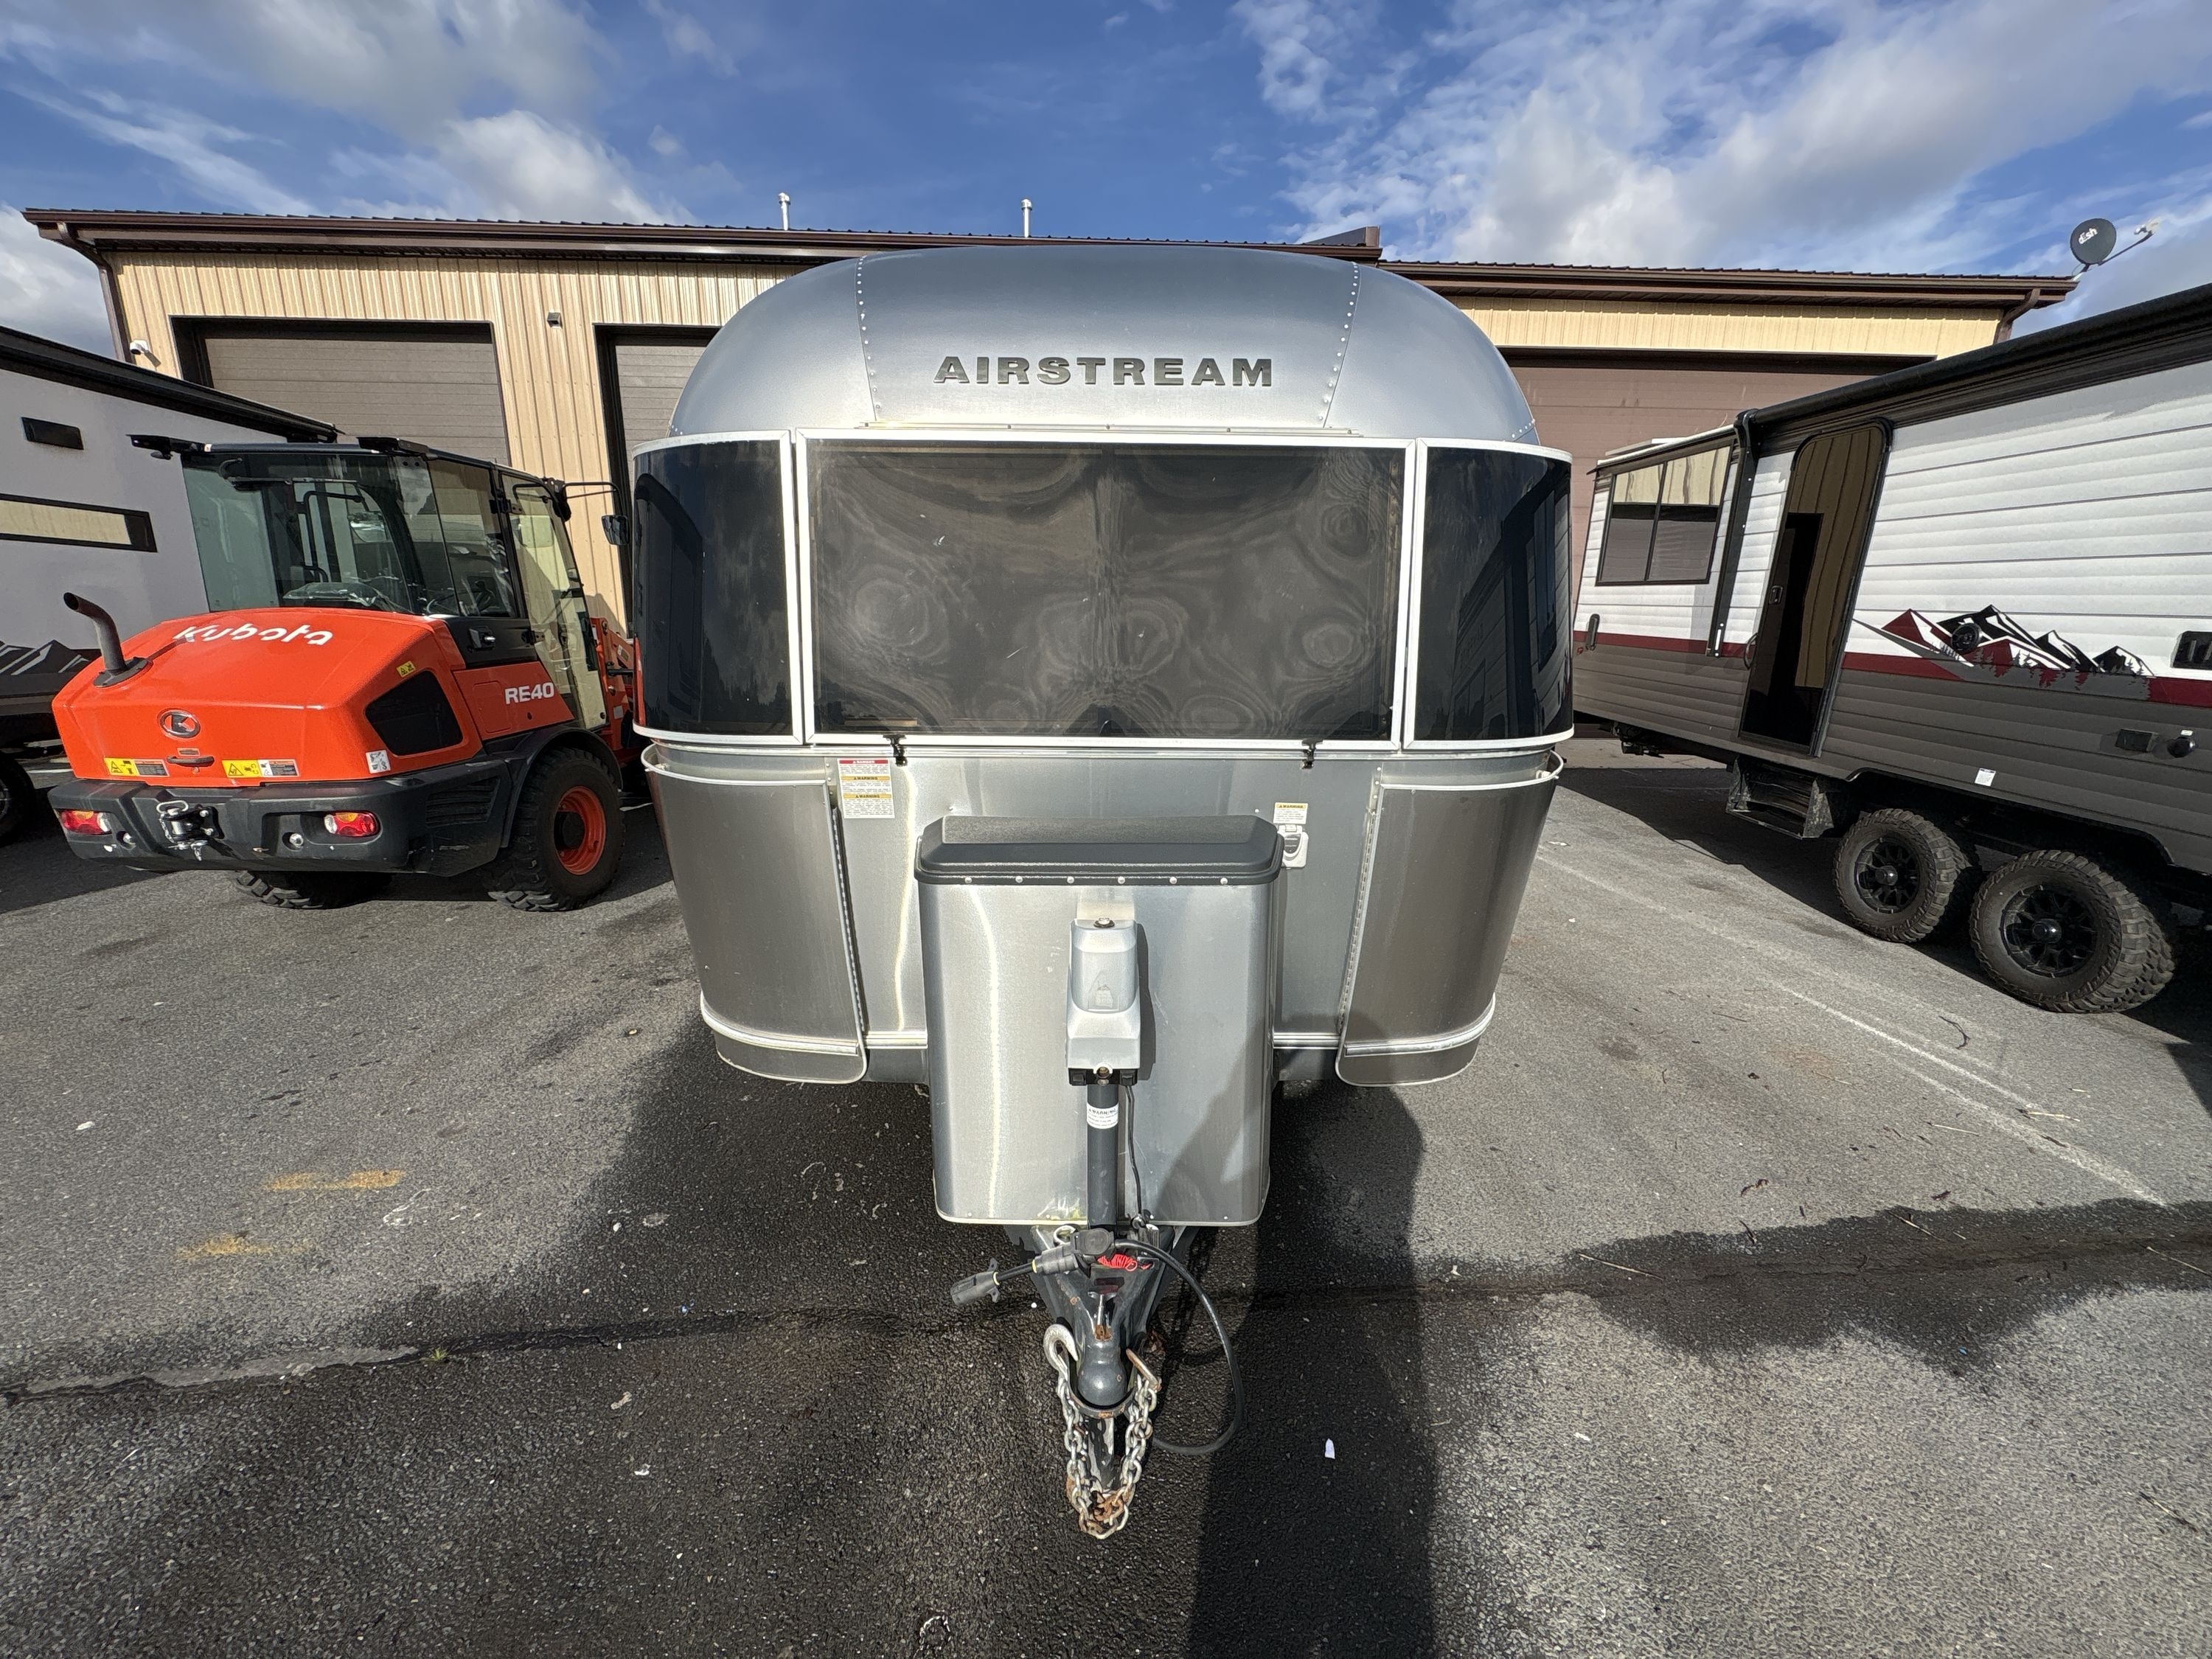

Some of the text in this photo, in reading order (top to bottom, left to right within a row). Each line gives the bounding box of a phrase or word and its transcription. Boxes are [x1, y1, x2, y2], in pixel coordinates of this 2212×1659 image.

[933, 355, 1272, 387] AIRSTREAM
[172, 623, 333, 646] Kubota
[504, 682, 554, 705] RE40
